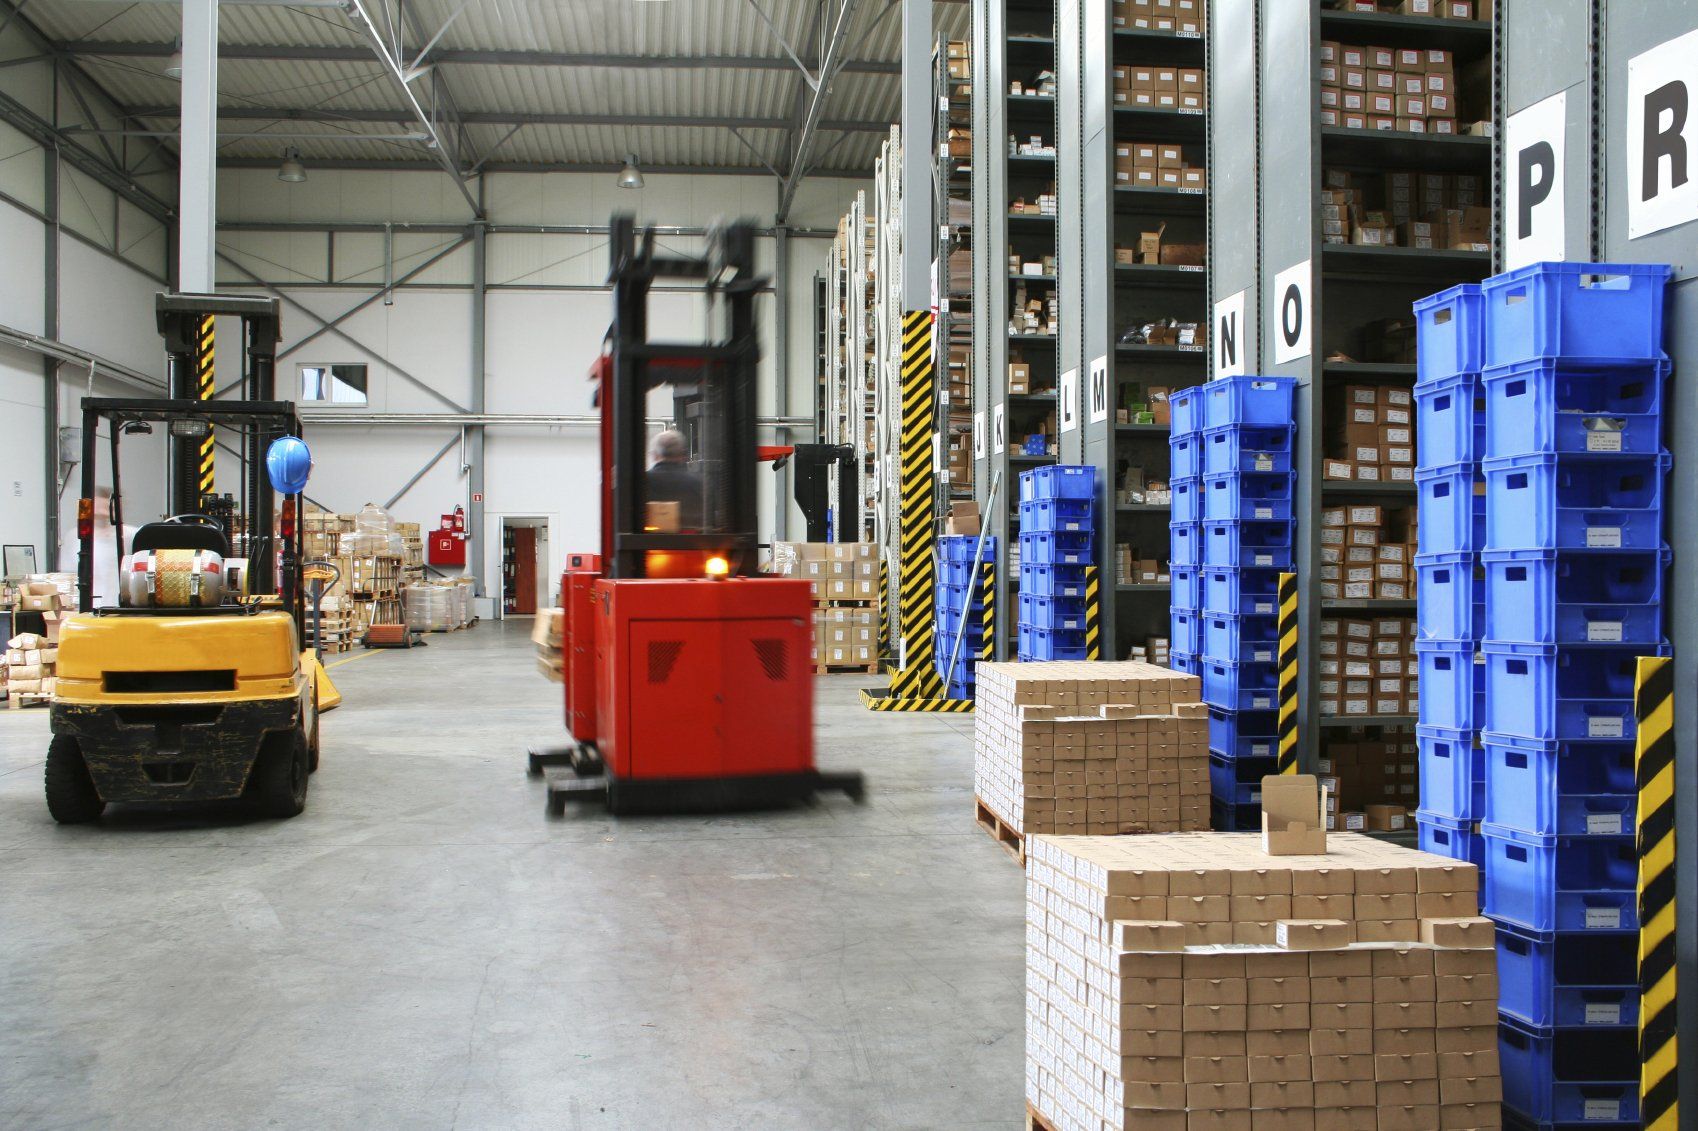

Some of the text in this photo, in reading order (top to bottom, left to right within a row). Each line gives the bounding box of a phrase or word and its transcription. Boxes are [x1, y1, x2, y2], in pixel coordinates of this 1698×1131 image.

[1642, 79, 1689, 202] R
[1518, 140, 1555, 240] P
[1221, 311, 1236, 369] N
[1282, 283, 1303, 348] O
[1064, 384, 1071, 422] L
[1093, 368, 1105, 413] M
[976, 422, 981, 453] J
[996, 413, 1003, 446] K
